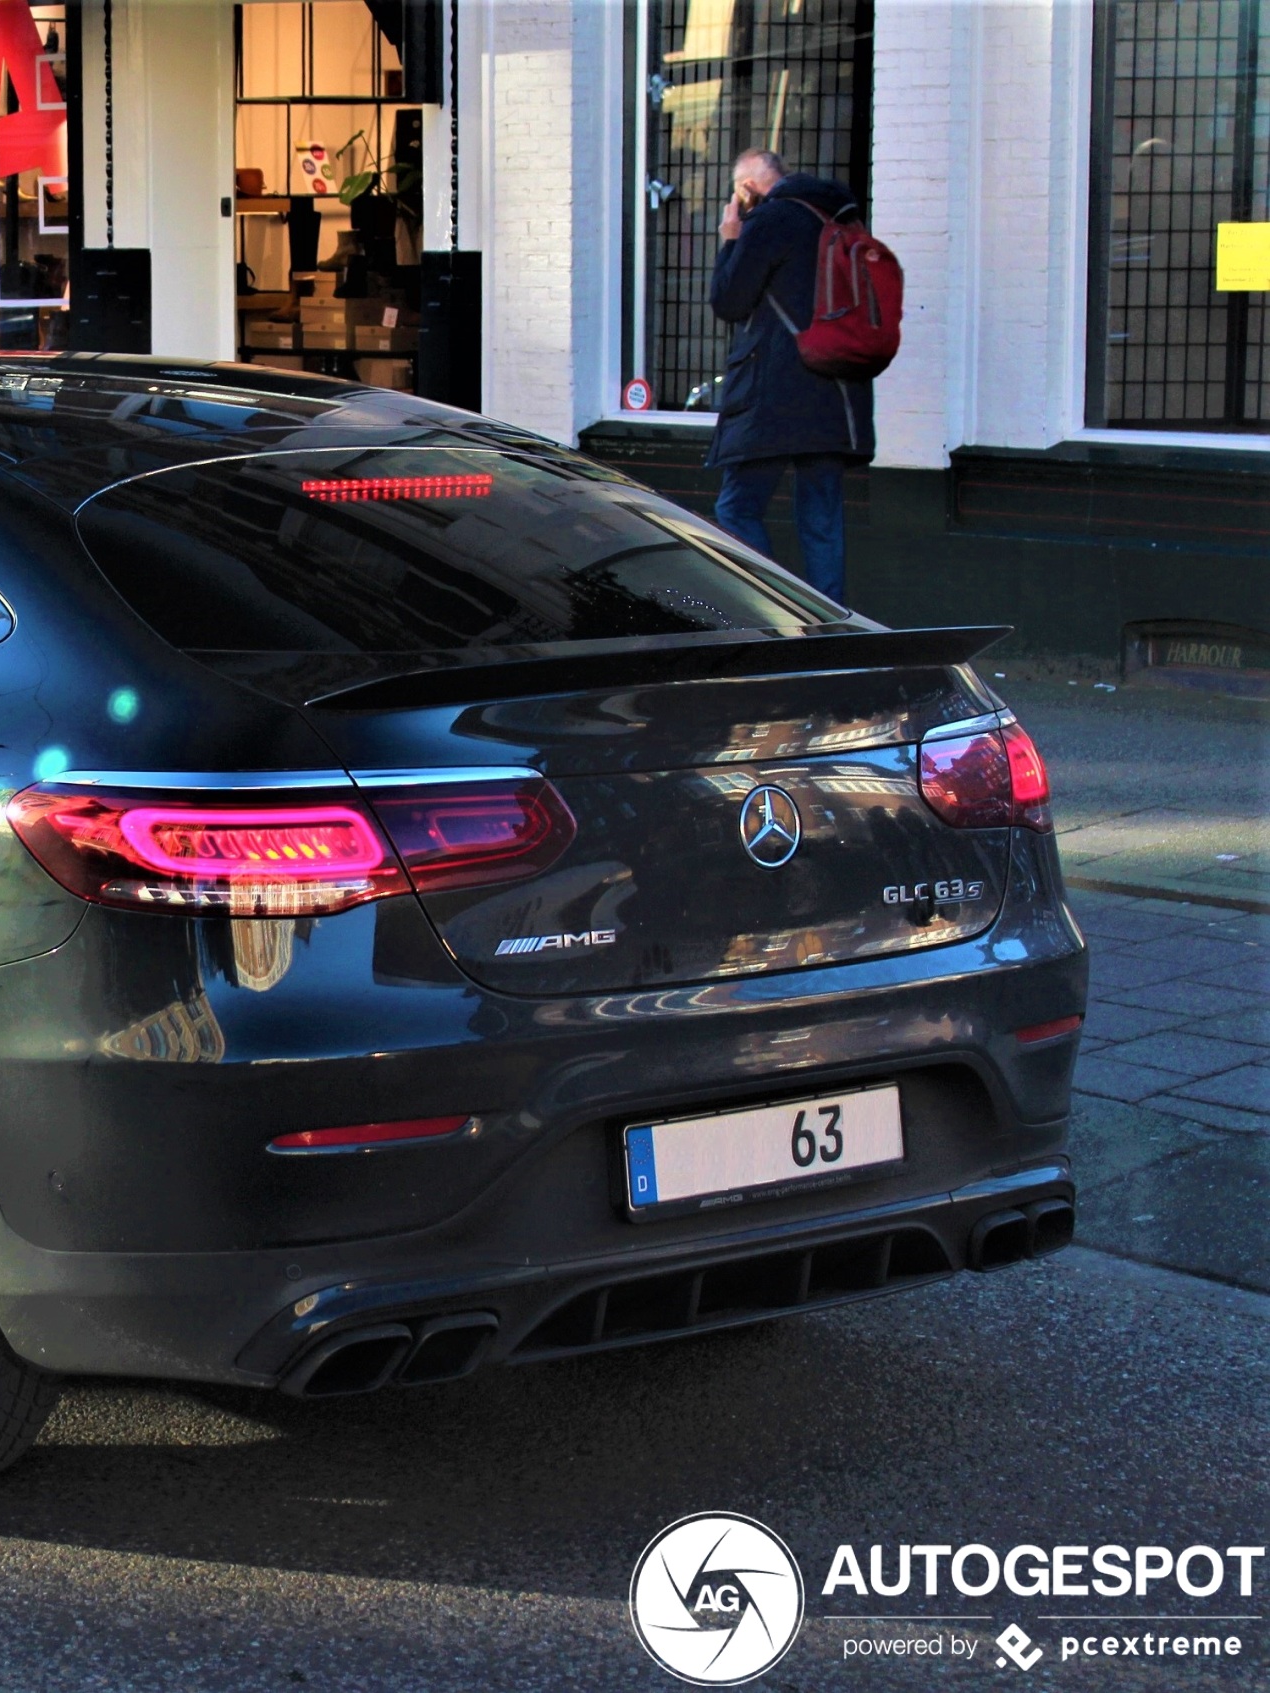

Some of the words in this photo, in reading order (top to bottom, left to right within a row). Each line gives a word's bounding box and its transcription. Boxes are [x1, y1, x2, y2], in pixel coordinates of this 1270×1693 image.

[1166, 641, 1242, 669] HARBOUR
[883, 883, 930, 905] GLC
[791, 1104, 844, 1168] 63
[637, 1175, 648, 1193] D
